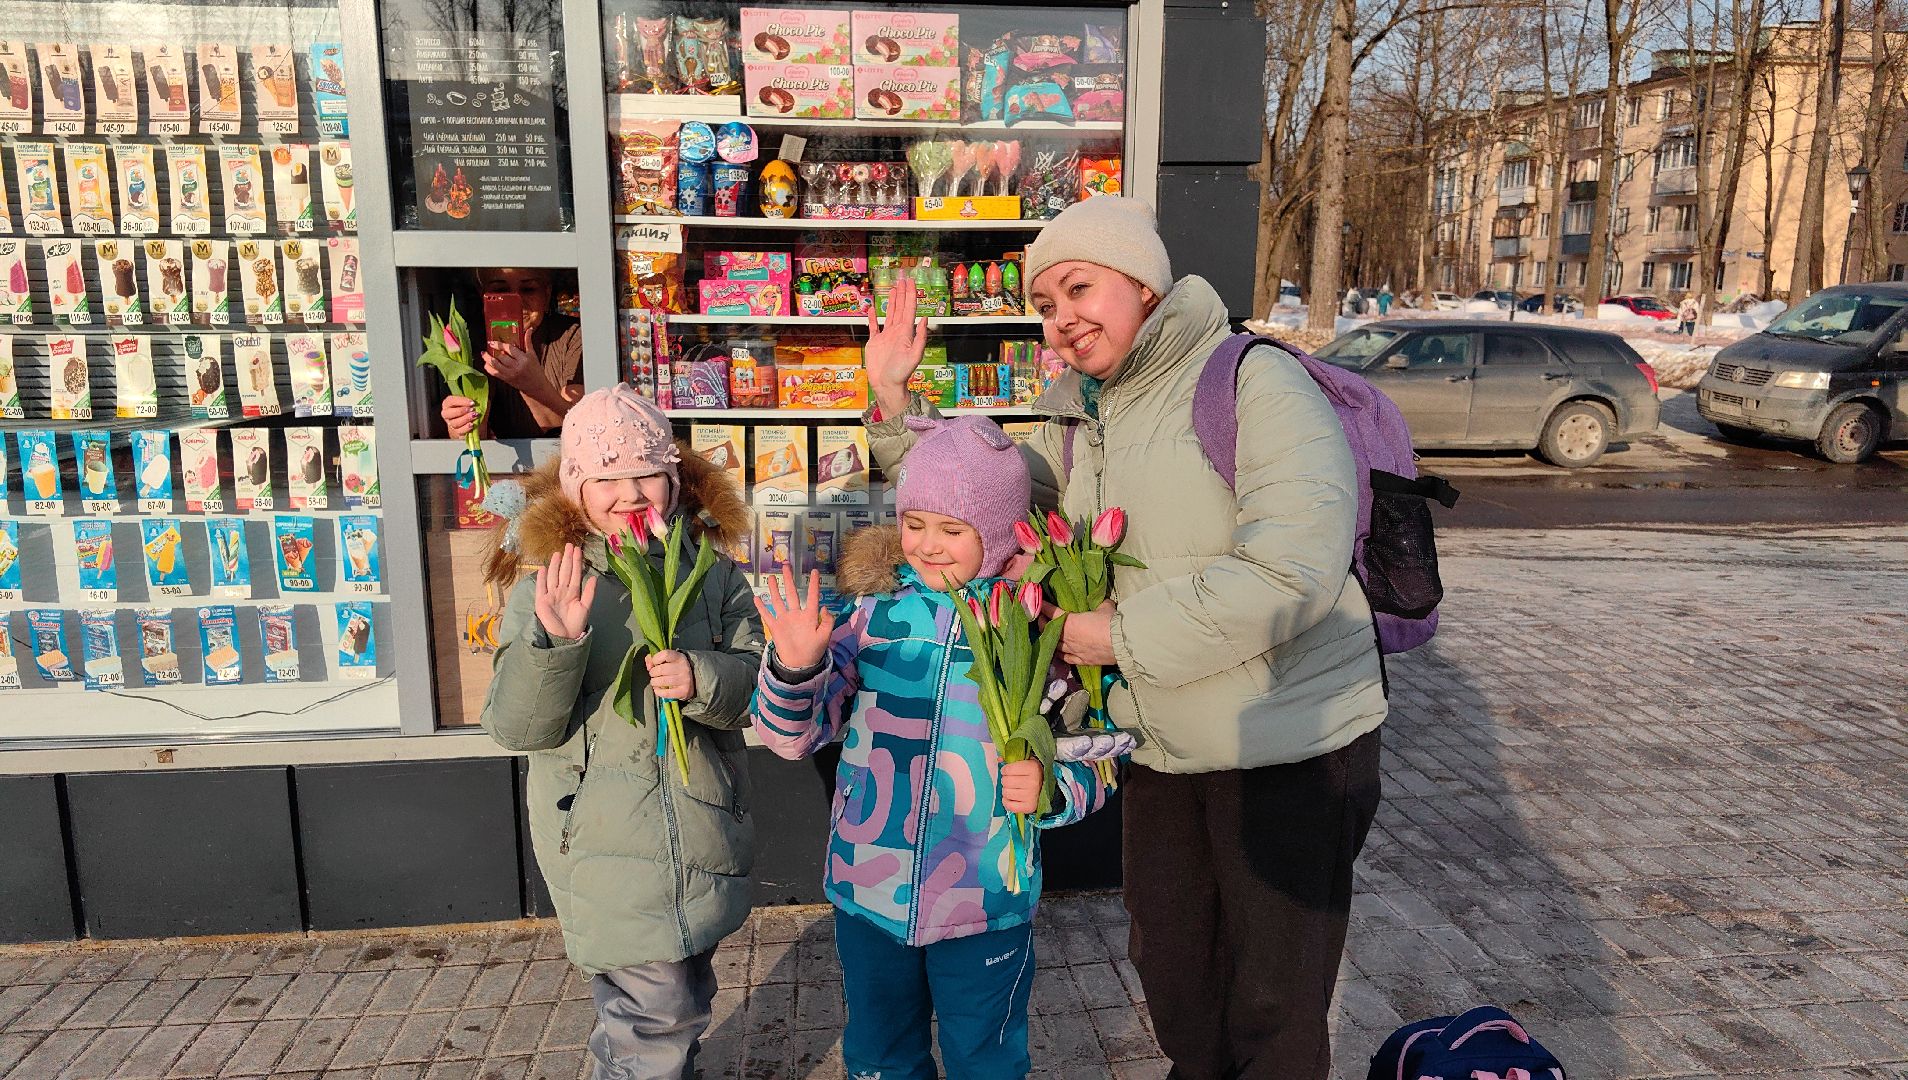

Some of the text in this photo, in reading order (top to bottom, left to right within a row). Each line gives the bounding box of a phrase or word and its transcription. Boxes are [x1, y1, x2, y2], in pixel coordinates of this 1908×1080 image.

[765, 24, 826, 38] Choco Pie
[876, 25, 937, 40] Choco Pie
[770, 77, 830, 90] Choco Pie
[878, 79, 938, 93] Choco Pie
[621, 229, 670, 241] АКЦИЯ
